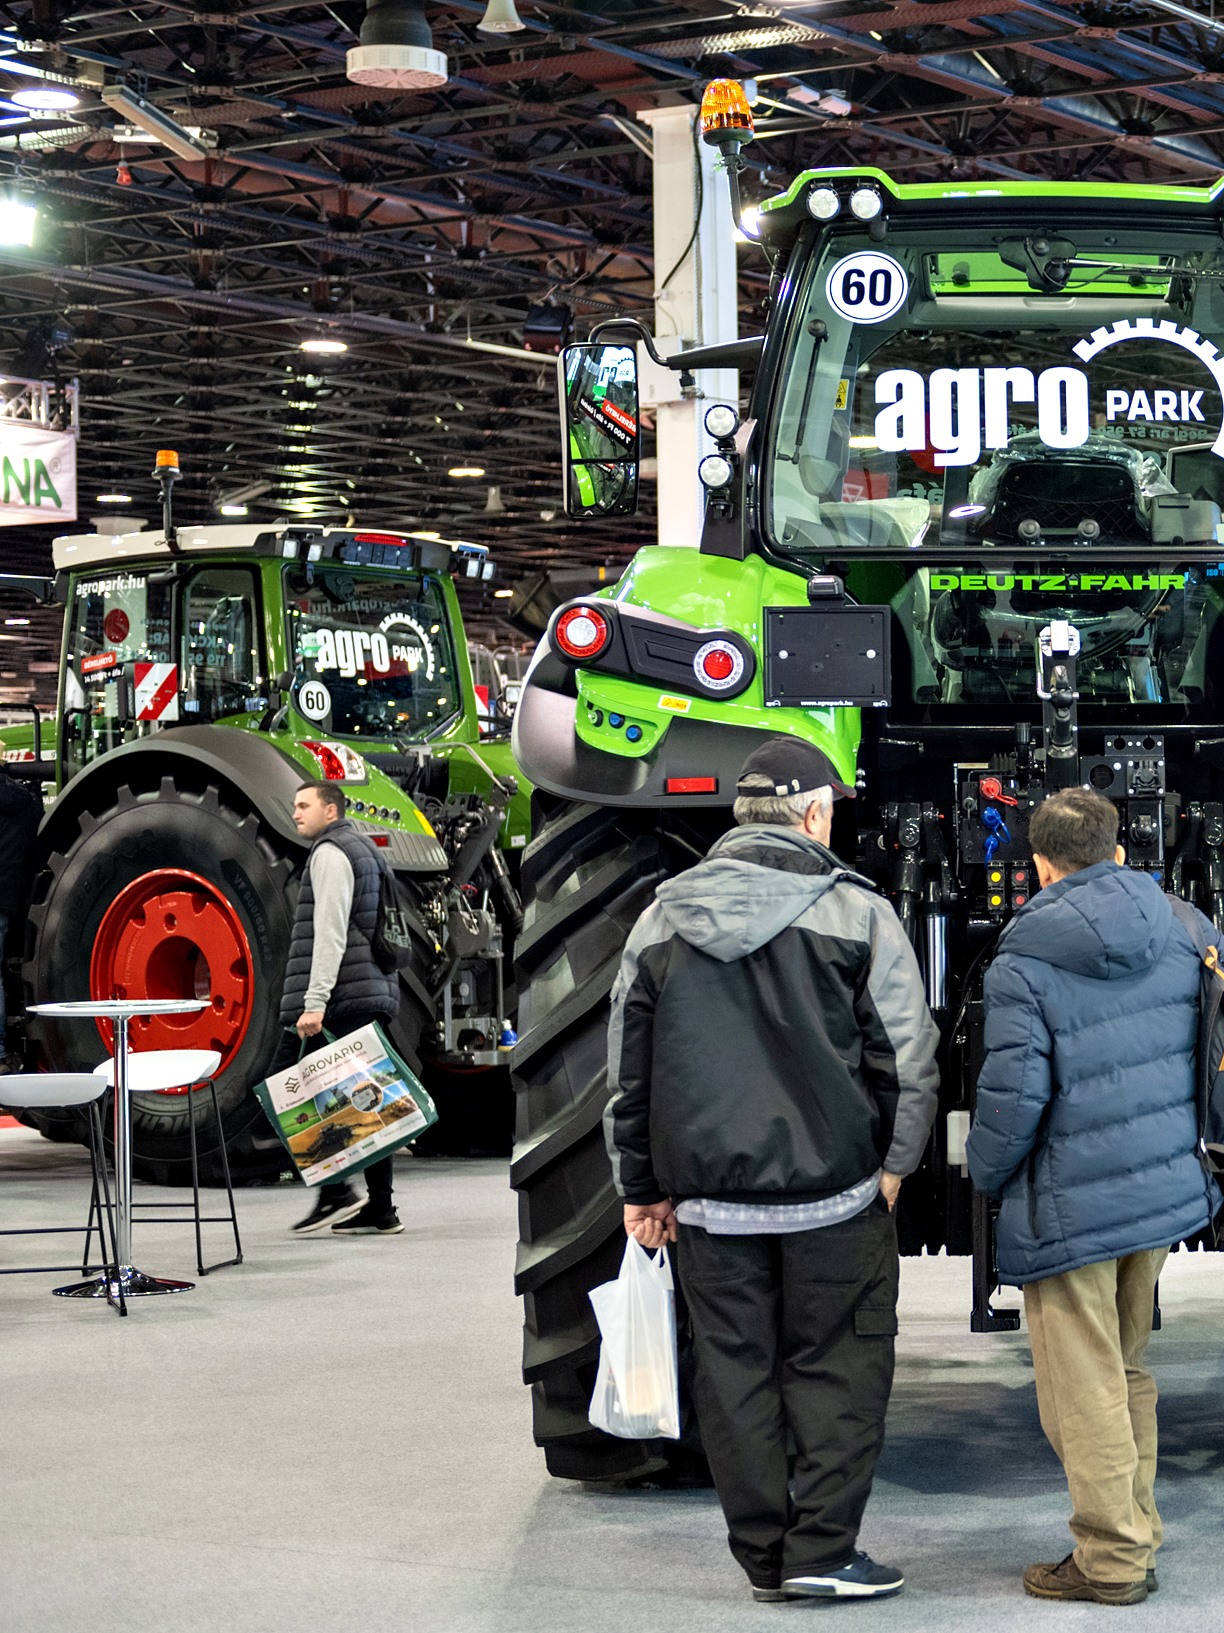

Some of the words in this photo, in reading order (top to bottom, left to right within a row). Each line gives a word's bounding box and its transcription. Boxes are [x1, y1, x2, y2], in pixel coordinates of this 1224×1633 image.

[842, 268, 892, 306] 60
[874, 365, 1089, 467] agro
[1106, 389, 1206, 421] PARK
[76, 575, 146, 598] agropark.hu
[930, 574, 1186, 591] DEUTZ-FAHR
[316, 628, 390, 677] agro
[392, 645, 424, 663] PARK
[305, 690, 325, 710] 60
[302, 1040, 363, 1080] AGROVARIO
